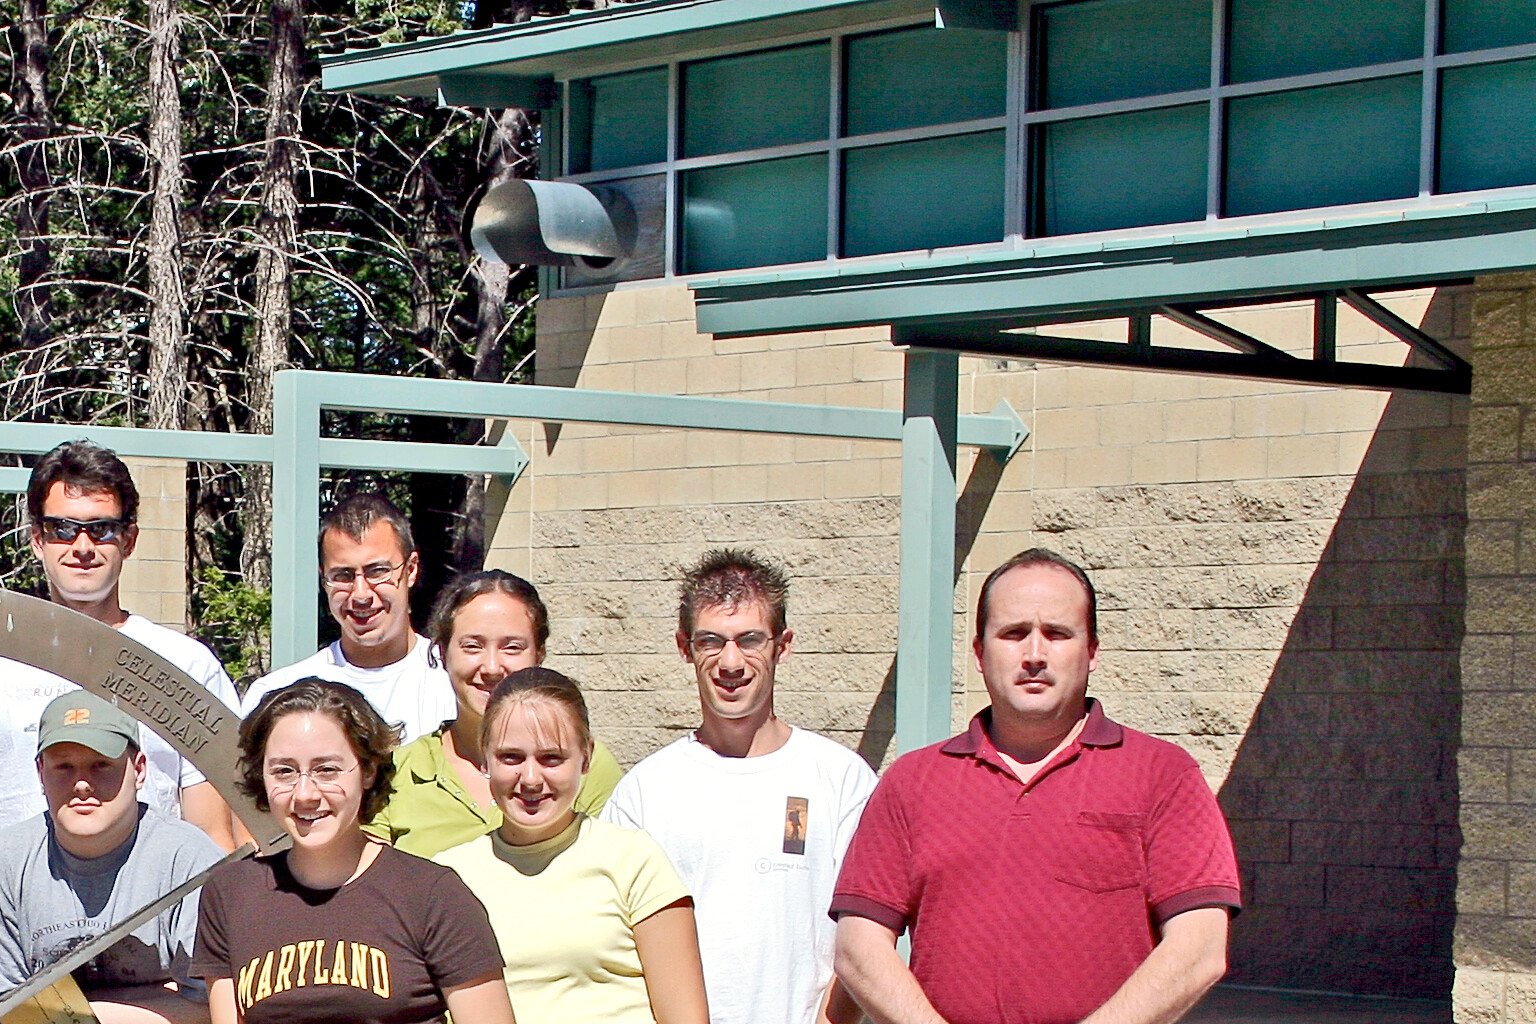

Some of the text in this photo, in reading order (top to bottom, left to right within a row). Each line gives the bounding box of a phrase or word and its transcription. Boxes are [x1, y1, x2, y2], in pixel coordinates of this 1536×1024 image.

[101, 669, 208, 755] MERIDIAN
[114, 646, 221, 736] CELESTIAL
[237, 938, 392, 1017] MARYLAND
